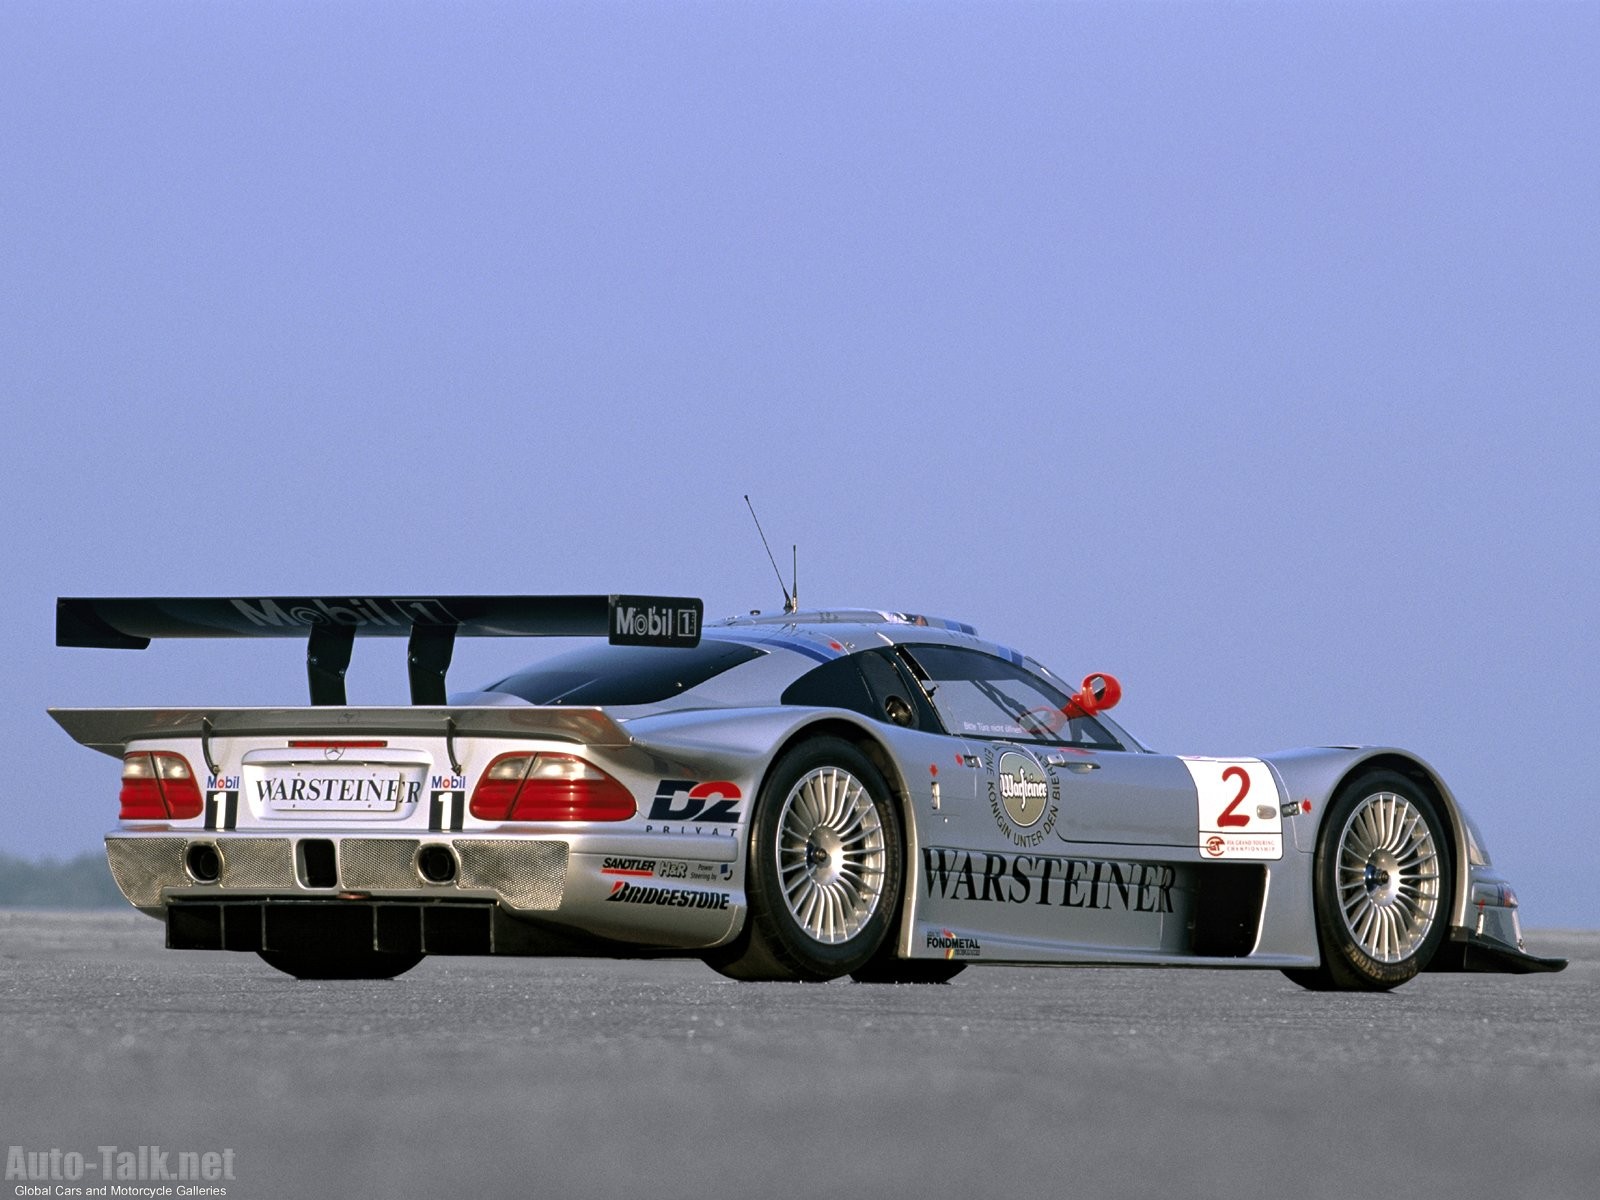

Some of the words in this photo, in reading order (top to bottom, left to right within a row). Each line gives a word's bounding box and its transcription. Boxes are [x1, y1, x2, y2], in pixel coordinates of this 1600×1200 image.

[616, 606, 672, 636] Mobil
[206, 776, 240, 789] Mobil
[255, 777, 421, 804] WARSTEINER
[431, 776, 466, 789] Mobil
[648, 779, 743, 823] D2
[1216, 766, 1251, 828] 2
[645, 825, 737, 838] PRIVAT
[1013, 830, 1045, 848] UNTER
[1042, 805, 1059, 835] DEN
[602, 857, 656, 871] SANDTLER
[659, 861, 687, 878] H&R
[921, 848, 1176, 913] WARSTEINER
[605, 880, 730, 910] BRIDGESTONE
[926, 936, 981, 949] FONDMETAL
